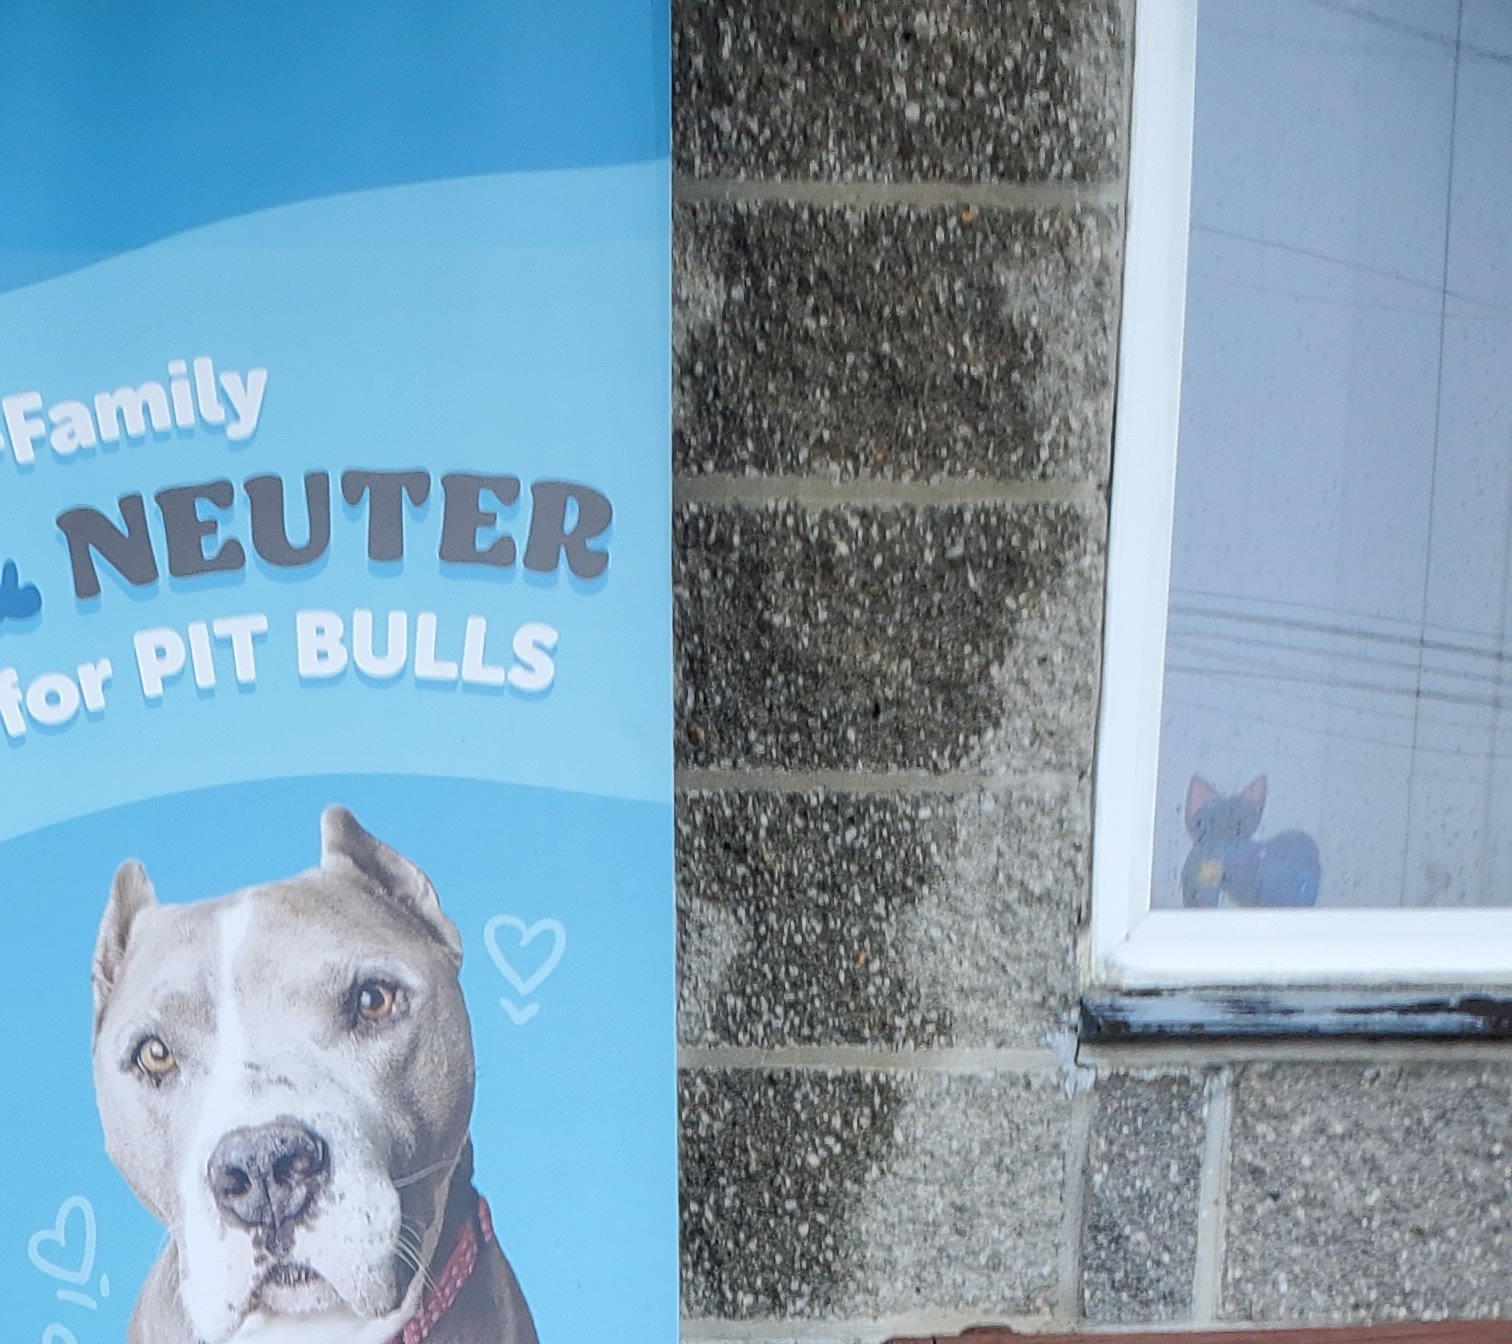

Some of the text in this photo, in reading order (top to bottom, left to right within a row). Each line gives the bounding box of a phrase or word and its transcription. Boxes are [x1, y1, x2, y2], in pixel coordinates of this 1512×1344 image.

[55, 468, 615, 599] NEUTER
[134, 614, 267, 700] PIT
[297, 609, 559, 694] BULLS
